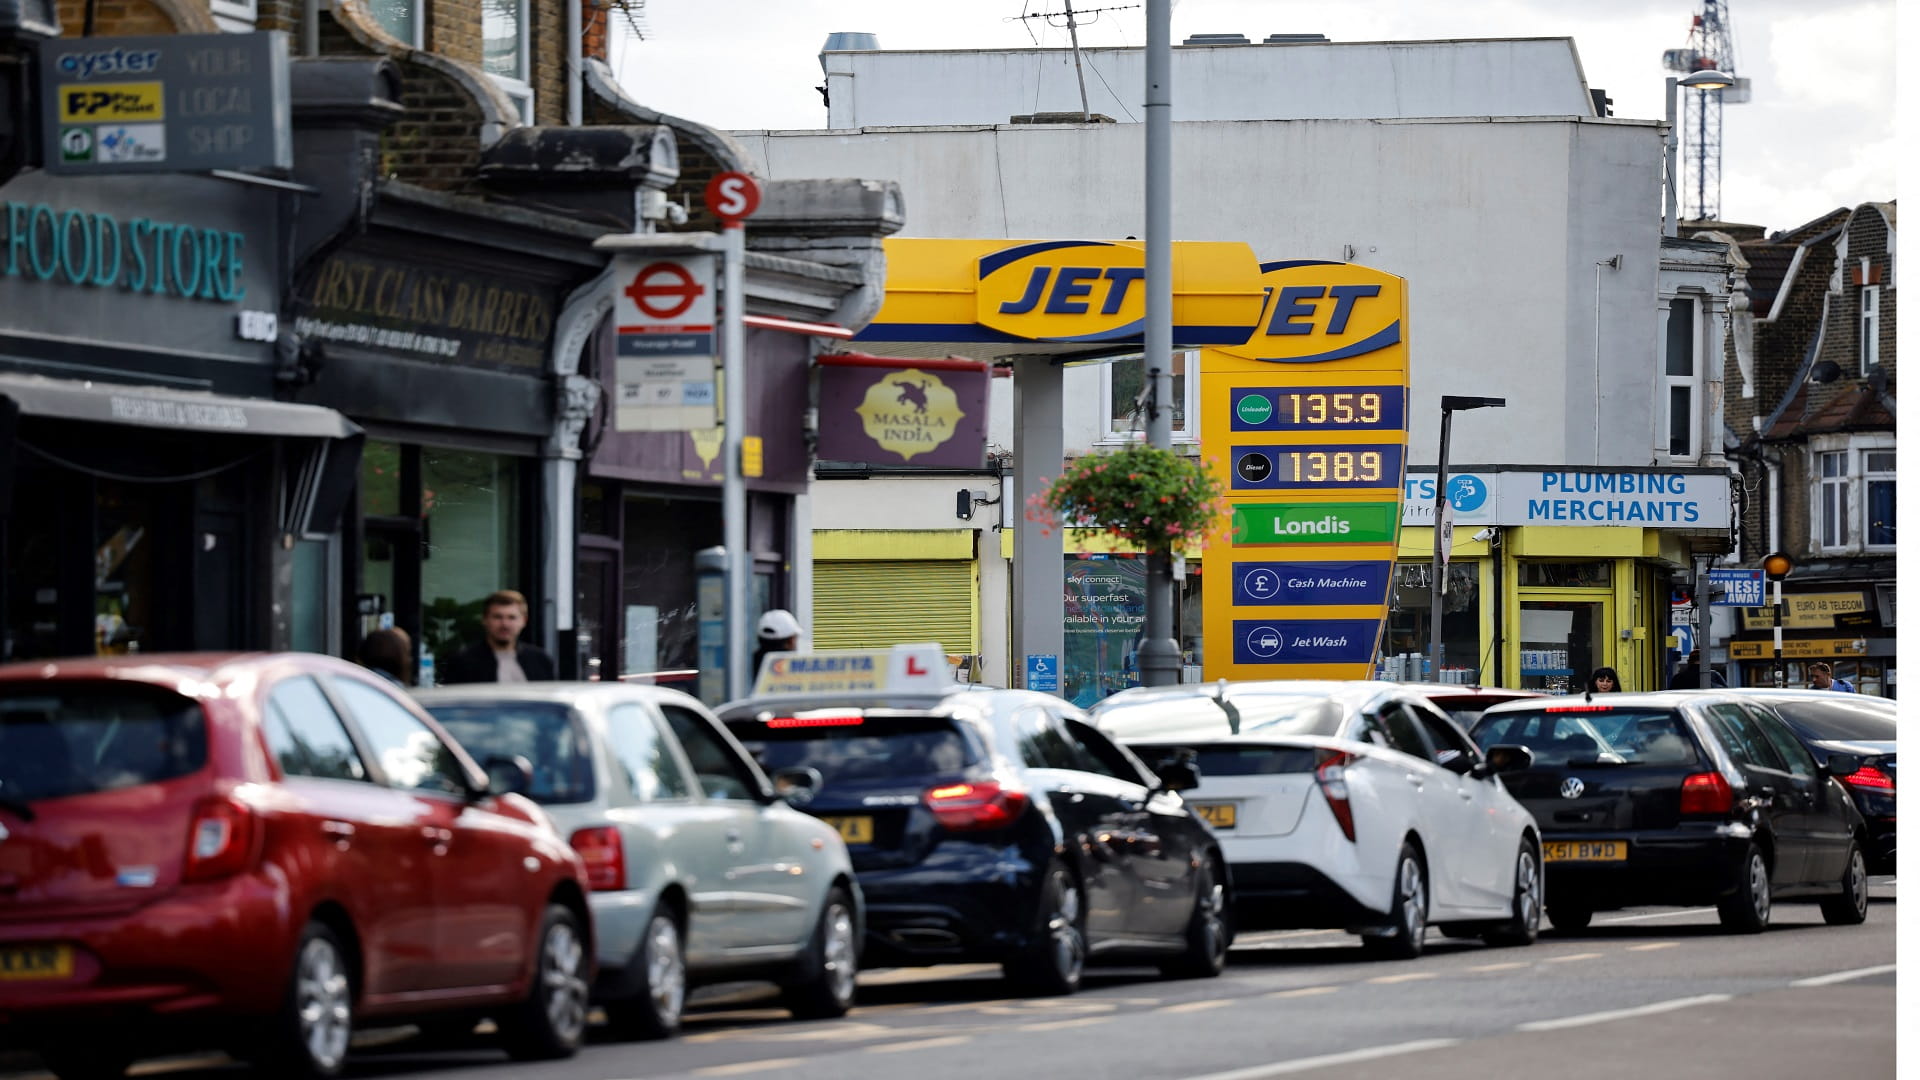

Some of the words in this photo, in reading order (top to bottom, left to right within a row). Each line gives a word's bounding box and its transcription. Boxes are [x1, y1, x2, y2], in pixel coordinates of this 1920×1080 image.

[58, 47, 160, 78] oyster
[718, 178, 747, 215] S
[6, 200, 122, 287] FOOD
[127, 216, 246, 302] STORE
[998, 267, 1146, 315] JET
[1260, 285, 1382, 336] ET
[1290, 393, 1380, 424] 135.9
[873, 413, 946, 428] MASALA
[1245, 463, 1265, 471] Diesel
[1290, 451, 1380, 482] 138.9
[1542, 472, 1686, 495] PLUMBING
[1528, 499, 1700, 523] MERCHANTS
[1274, 515, 1350, 535] Londis
[1067, 576, 1082, 584] sky
[1287, 578, 1314, 588] Cash
[1317, 577, 1367, 588] Machine
[1081, 593, 1129, 603] superfast
[1728, 594, 1760, 603] AWAY
[1797, 602, 1816, 611] EURO
[1818, 601, 1828, 610] AB
[1830, 600, 1862, 610] TELECOM
[1100, 615, 1109, 623] in
[1111, 616, 1135, 625] your
[1291, 637, 1311, 647] Jet
[1313, 636, 1347, 646] Wash
[906, 657, 927, 676] L
[1579, 843, 1616, 857] BWD
